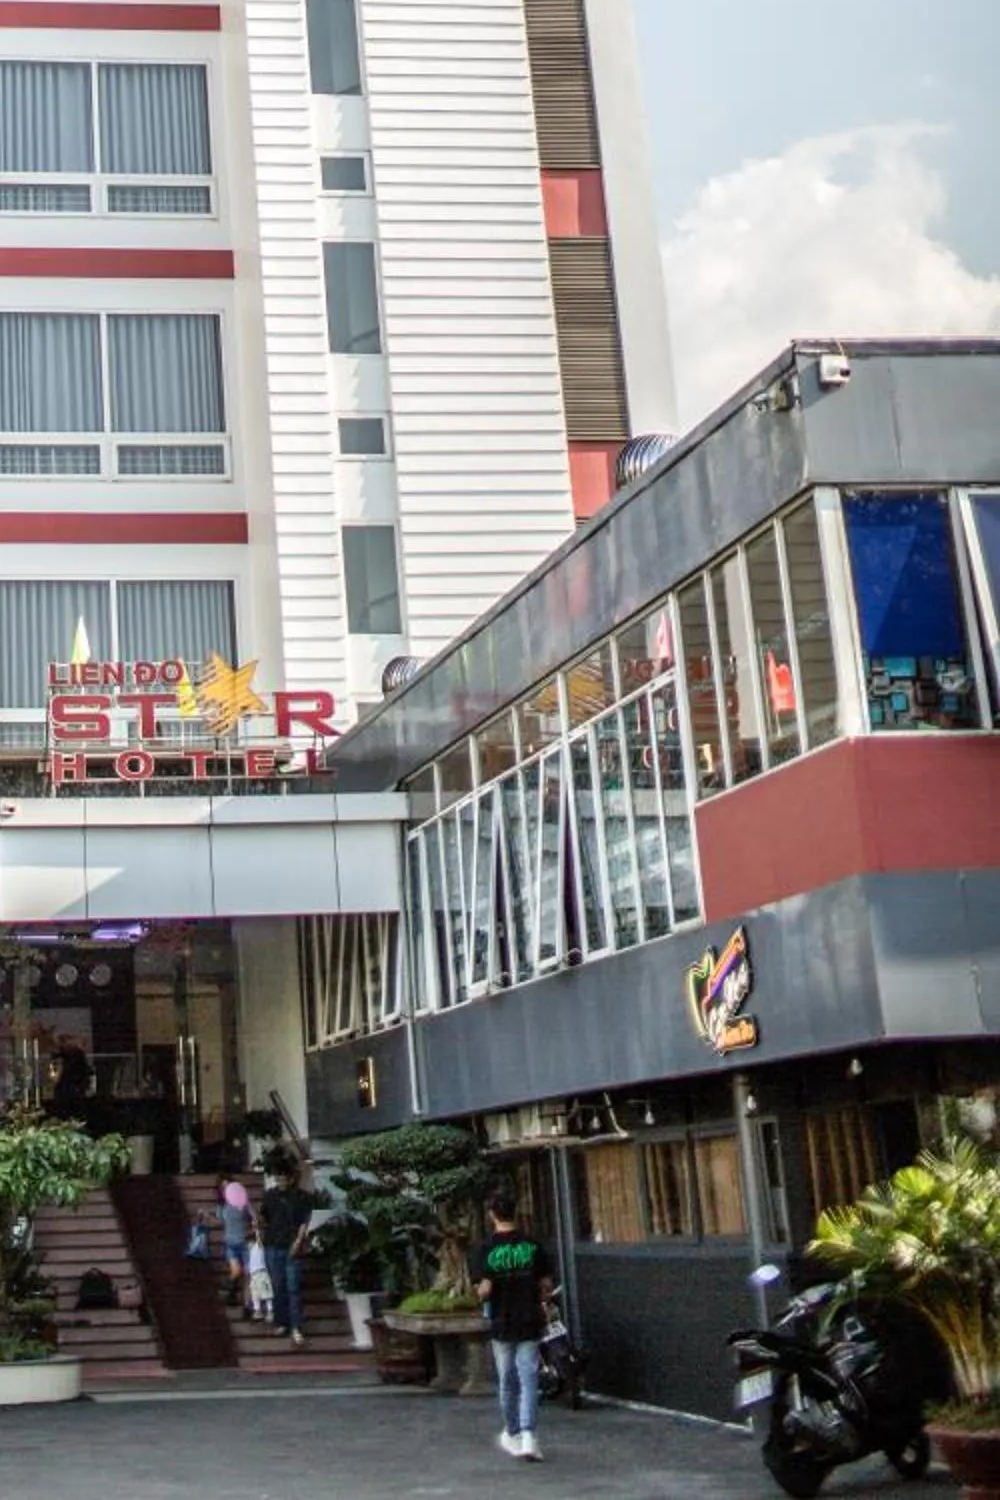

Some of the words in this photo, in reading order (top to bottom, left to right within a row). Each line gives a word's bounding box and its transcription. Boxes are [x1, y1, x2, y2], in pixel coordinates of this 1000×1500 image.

[50, 661, 125, 686] LIEN
[50, 690, 345, 741] STR
[52, 748, 338, 783] HOTEL
